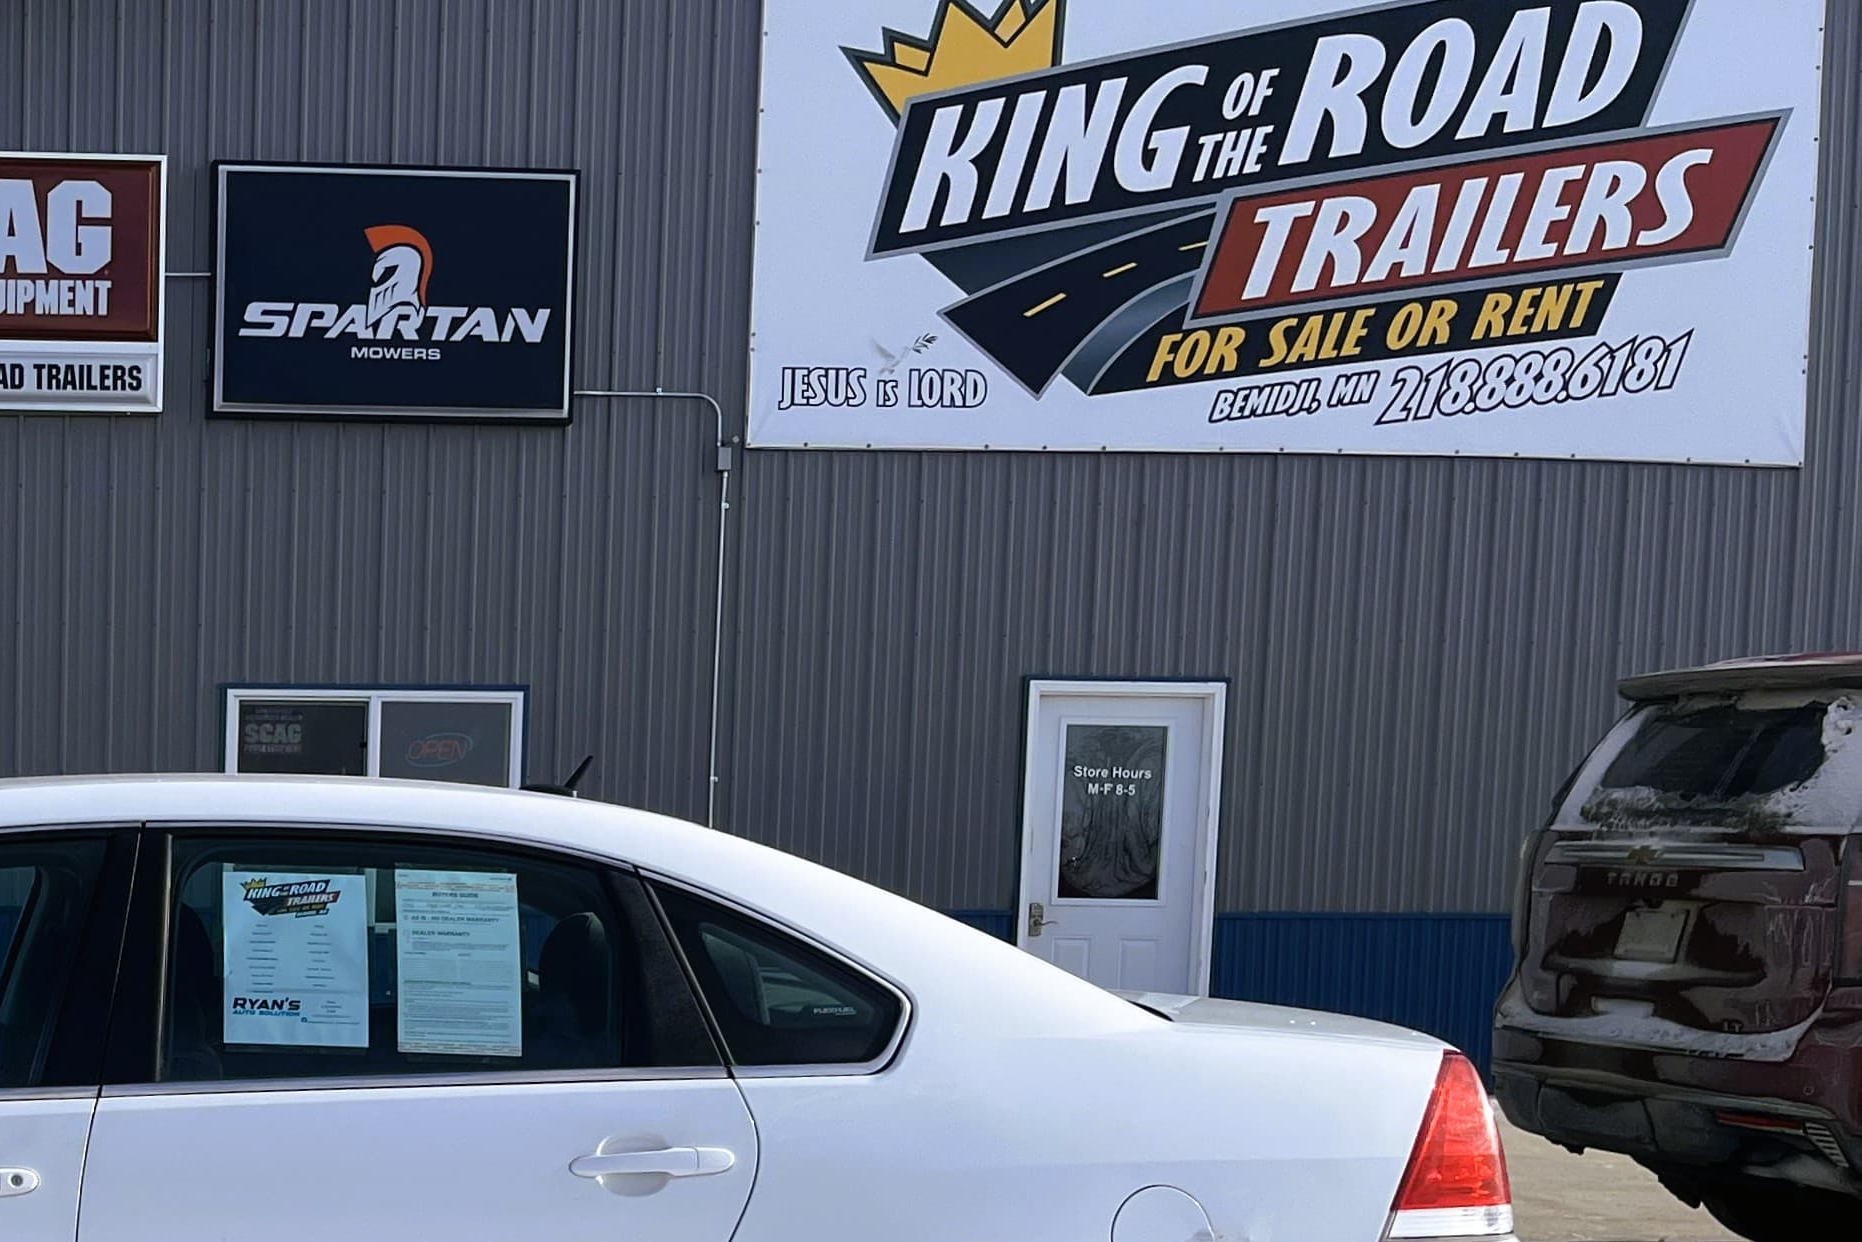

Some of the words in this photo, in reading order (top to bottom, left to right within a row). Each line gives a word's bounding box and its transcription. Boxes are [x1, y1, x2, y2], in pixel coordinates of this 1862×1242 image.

[1221, 68, 1280, 120] OF
[1277, 0, 1643, 166] ROAD
[898, 64, 1210, 234] KING
[1192, 125, 1274, 184] THE
[1240, 148, 1714, 300] TRAILERS
[238, 301, 551, 343] SPARTAN
[1145, 326, 1245, 383] FOR
[1259, 308, 1375, 367] SALE
[1386, 299, 1458, 352] OR
[1471, 280, 1604, 339] RENT
[350, 346, 441, 360] MOWERS
[33, 363, 142, 391] TRAILERS
[778, 367, 867, 410] JESUS
[908, 368, 987, 408] LORD
[1208, 378, 1322, 423] BEMIDJI,
[1327, 370, 1380, 408] MN
[1373, 328, 1695, 426] 218.888.6181
[244, 723, 302, 743] SCAG
[409, 740, 467, 760] OPEN
[1073, 765, 1109, 778] Store
[1112, 766, 1152, 779] Hours
[1115, 783, 1136, 796] 8-5
[247, 886, 282, 899] KING
[289, 882, 326, 896] ROAD
[287, 893, 335, 906] TRAILERS
[232, 997, 301, 1011] RYAN'S
